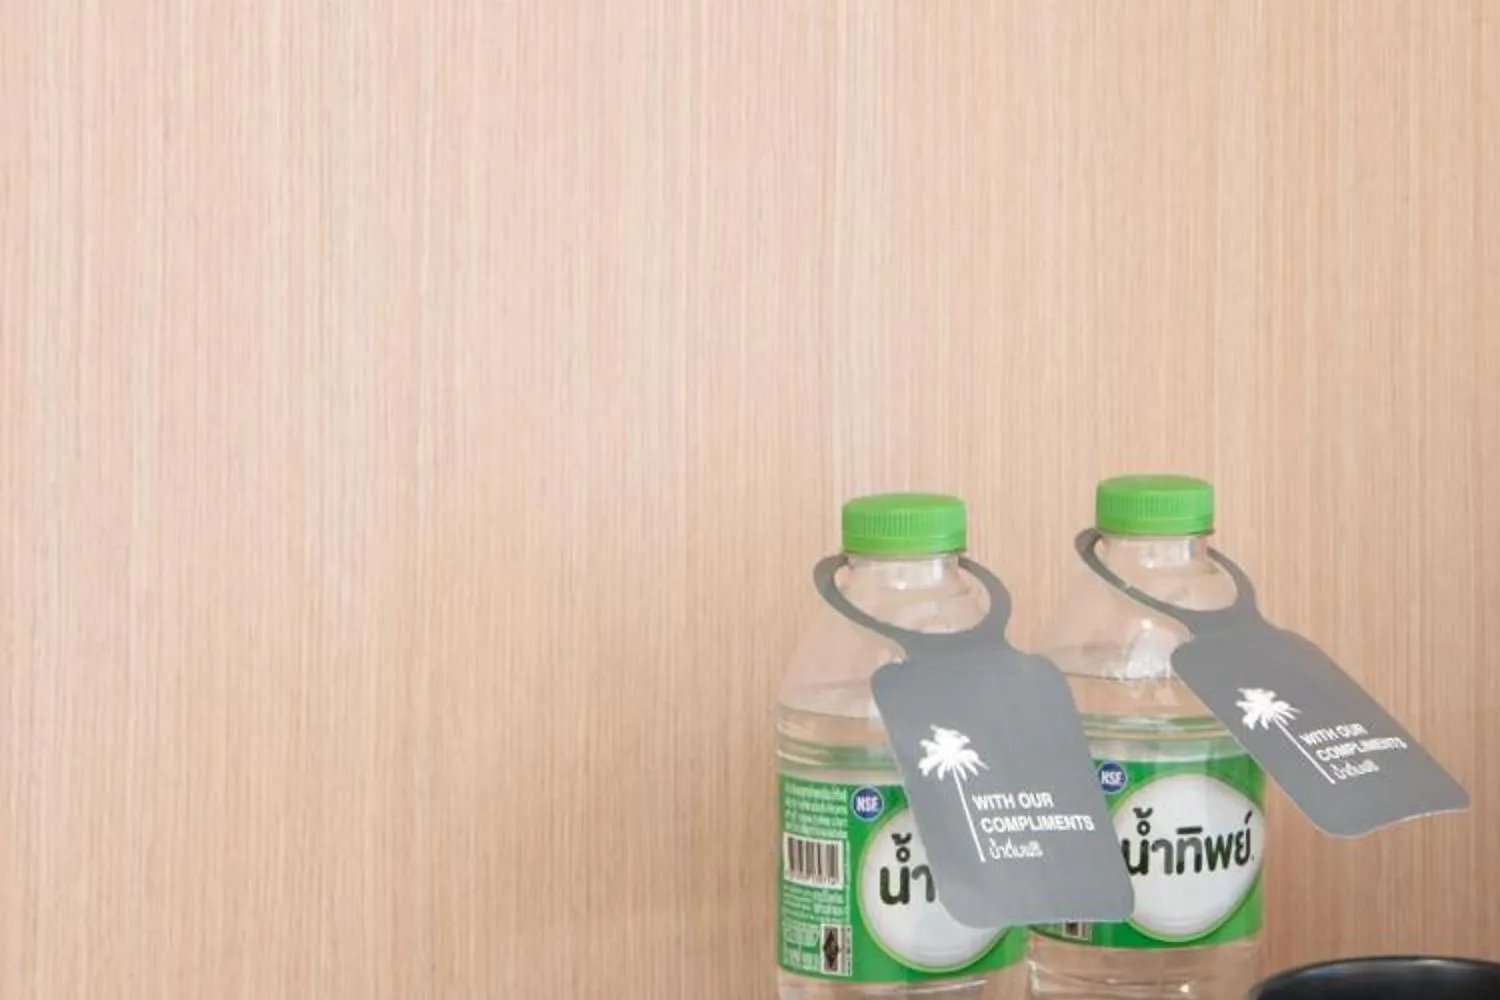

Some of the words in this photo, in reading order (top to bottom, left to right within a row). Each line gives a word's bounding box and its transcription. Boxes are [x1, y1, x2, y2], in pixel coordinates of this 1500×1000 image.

[1101, 771, 1122, 785] NSF
[855, 796, 880, 812] NSF
[972, 792, 1016, 811] WITH
[1018, 791, 1055, 809] OUR
[981, 814, 1095, 833] COMPLIMENTS
[1121, 806, 1253, 876] น้ำทิพย์
